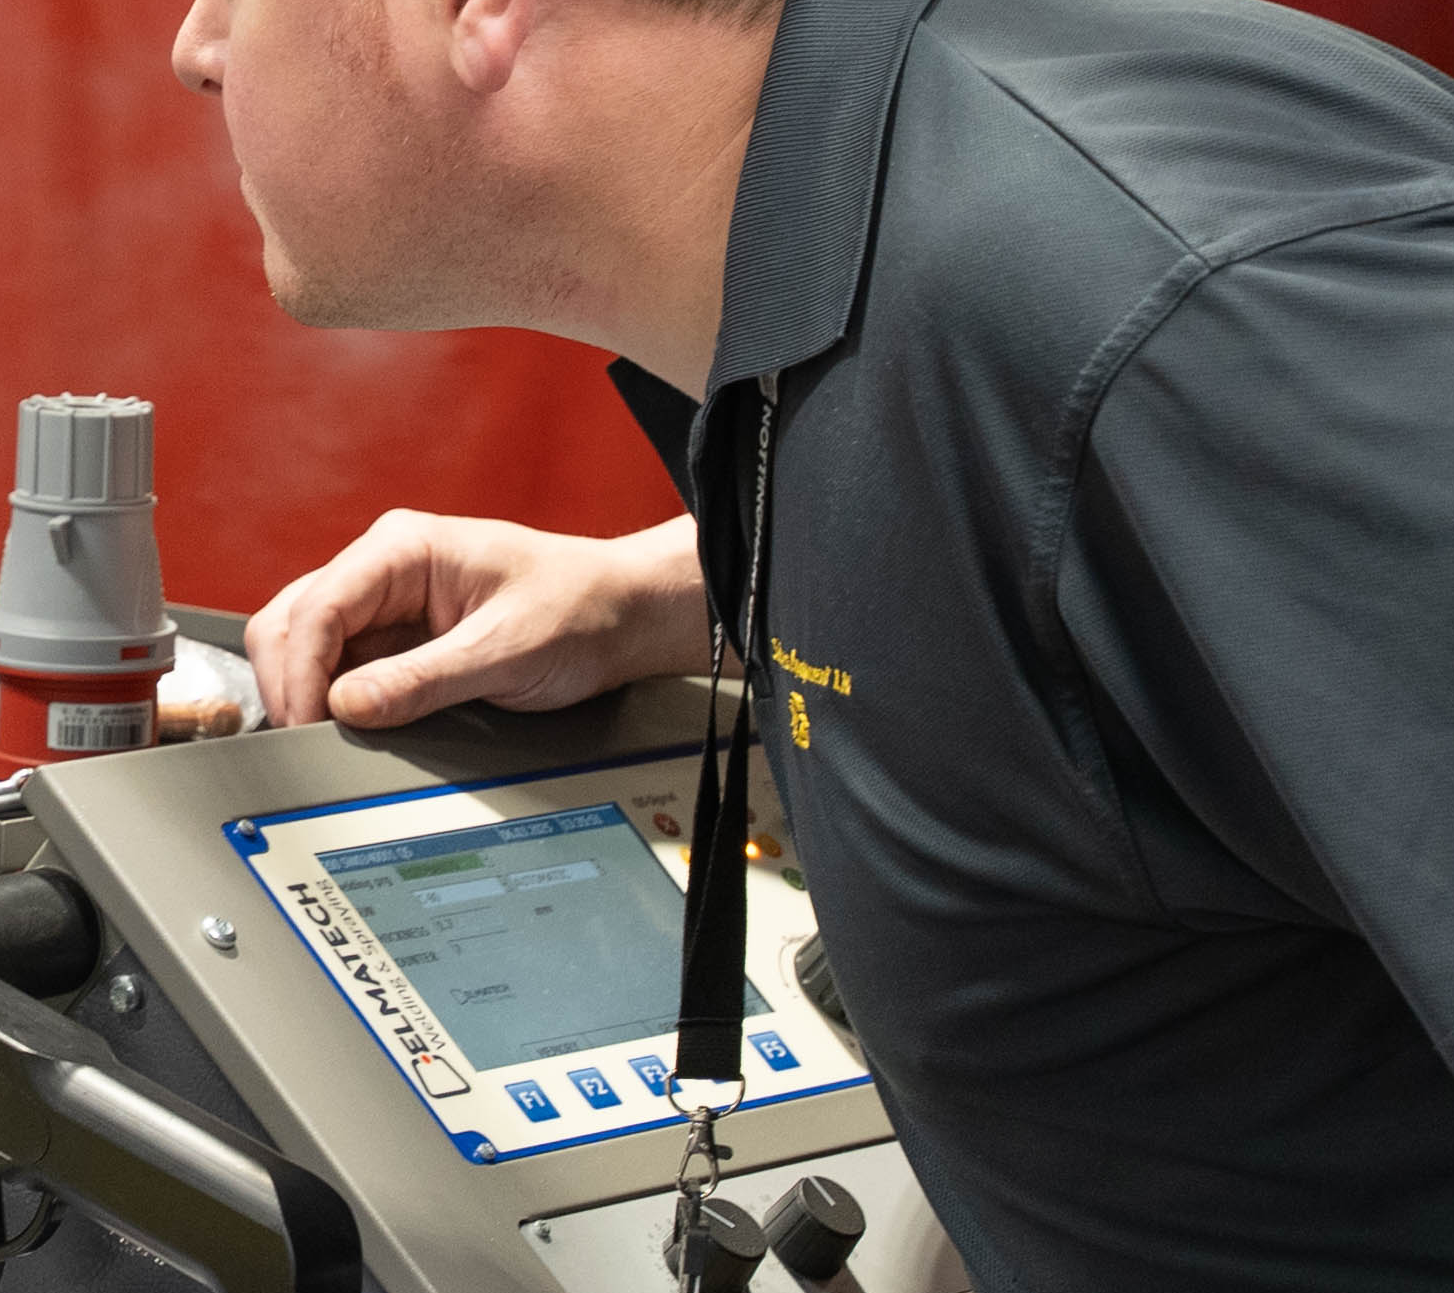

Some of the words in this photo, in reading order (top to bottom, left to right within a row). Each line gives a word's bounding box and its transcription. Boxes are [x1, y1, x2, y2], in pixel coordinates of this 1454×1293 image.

[287, 882, 430, 1055] ELMATECH
[390, 975, 446, 1051] Welding
[760, 1040, 787, 1059] F5
[579, 1076, 608, 1098] F2
[519, 1089, 546, 1110] F1
